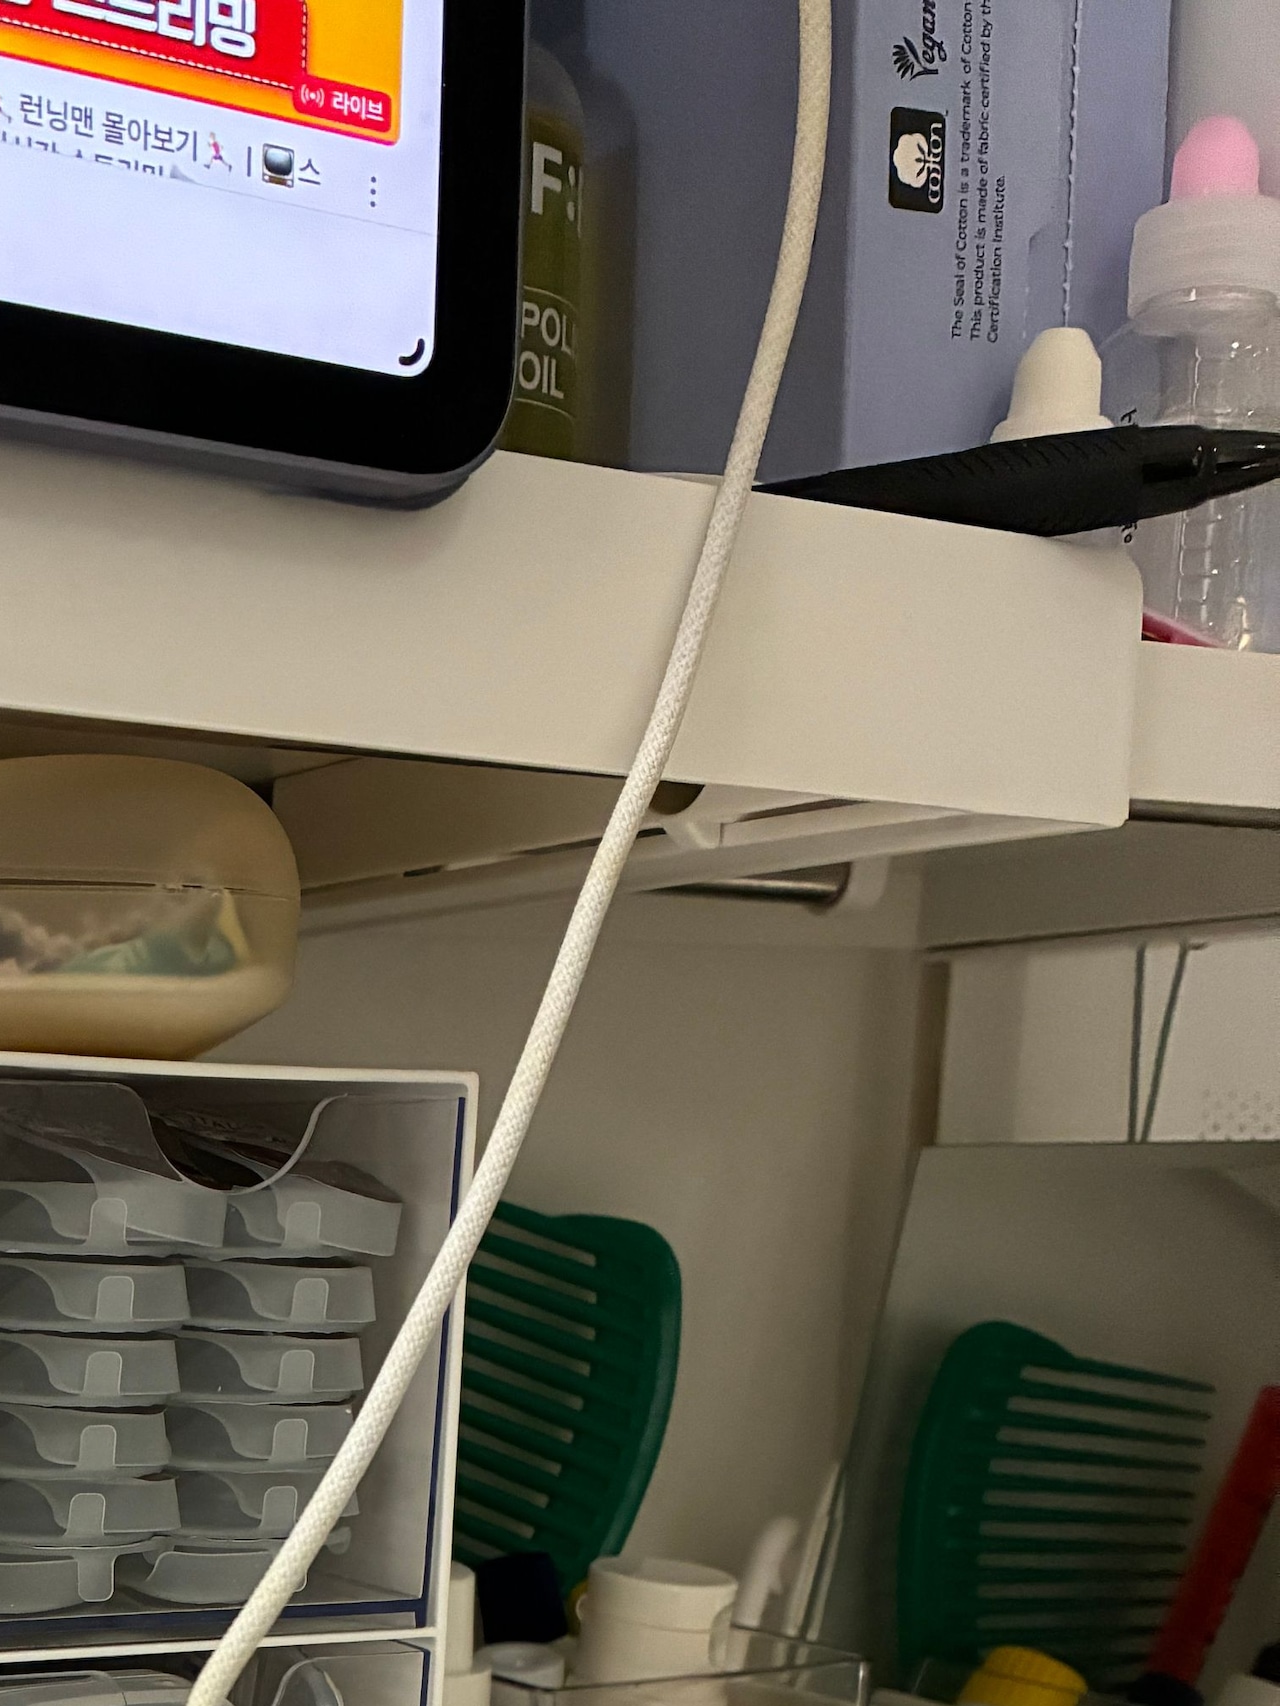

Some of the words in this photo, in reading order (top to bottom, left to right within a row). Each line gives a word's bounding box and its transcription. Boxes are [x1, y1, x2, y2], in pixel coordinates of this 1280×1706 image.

[962, 1, 972, 55] Cotton
[981, 20, 993, 38] by
[961, 57, 971, 74] of
[979, 42, 990, 108] certified
[331, 90, 385, 121] 라이브
[960, 81, 971, 163] trademark
[19, 93, 95, 138] 런닝맨
[102, 110, 199, 161] 몰아보기
[927, 122, 943, 203] cotton
[961, 168, 969, 177] a
[978, 158, 988, 174] of
[959, 182, 969, 193] is
[976, 178, 988, 223] made
[956, 199, 968, 251] Cotton
[975, 228, 985, 240] is
[956, 255, 966, 271] of
[973, 244, 985, 306] product
[954, 275, 964, 306] Seal
[987, 248, 1002, 343] Certification
[521, 301, 575, 357] POL
[952, 310, 963, 339] The
[971, 309, 982, 341] This
[519, 351, 565, 400] OIL
